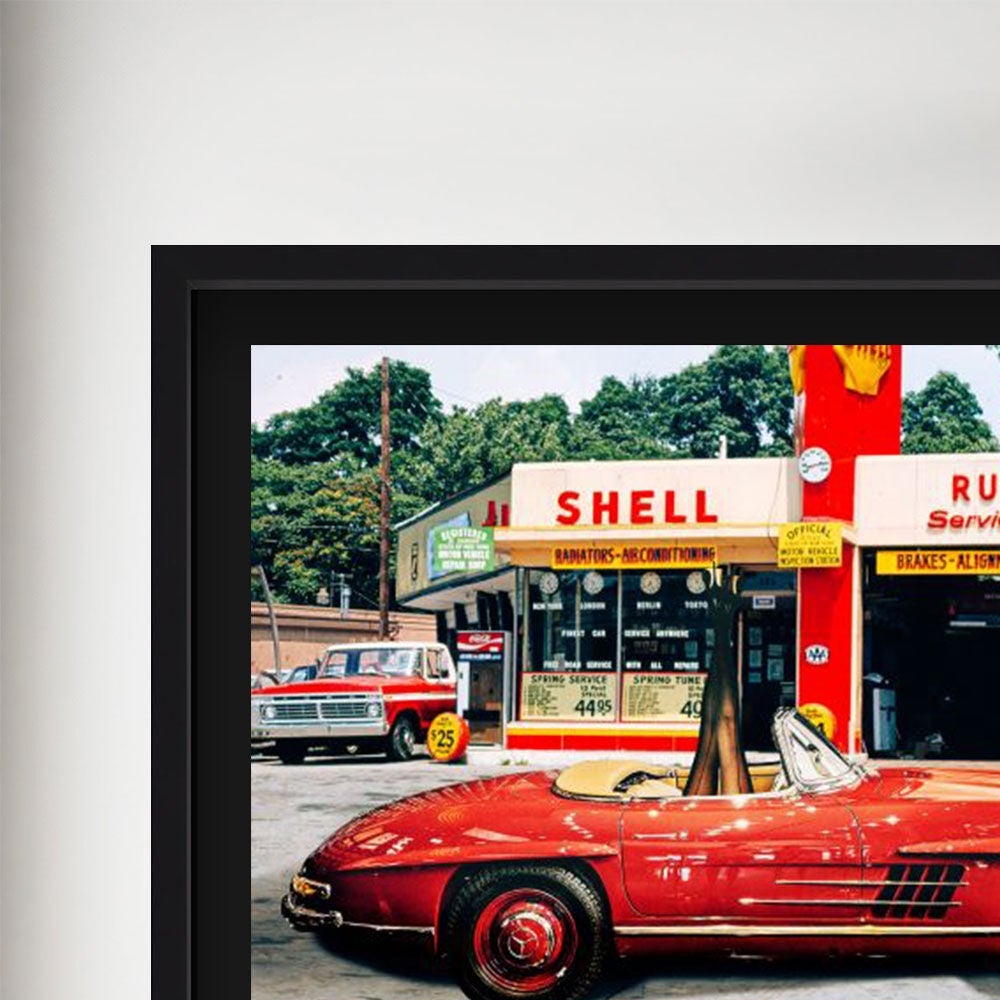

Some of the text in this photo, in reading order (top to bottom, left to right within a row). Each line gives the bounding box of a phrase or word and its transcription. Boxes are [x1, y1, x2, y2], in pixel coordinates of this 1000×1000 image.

[556, 490, 718, 525] SHELL
[786, 524, 831, 540] OFFICIAL
[808, 546, 838, 554] VEHICLE
[531, 675, 607, 684] SPRING SERVICE
[633, 676, 671, 685] SPRING
